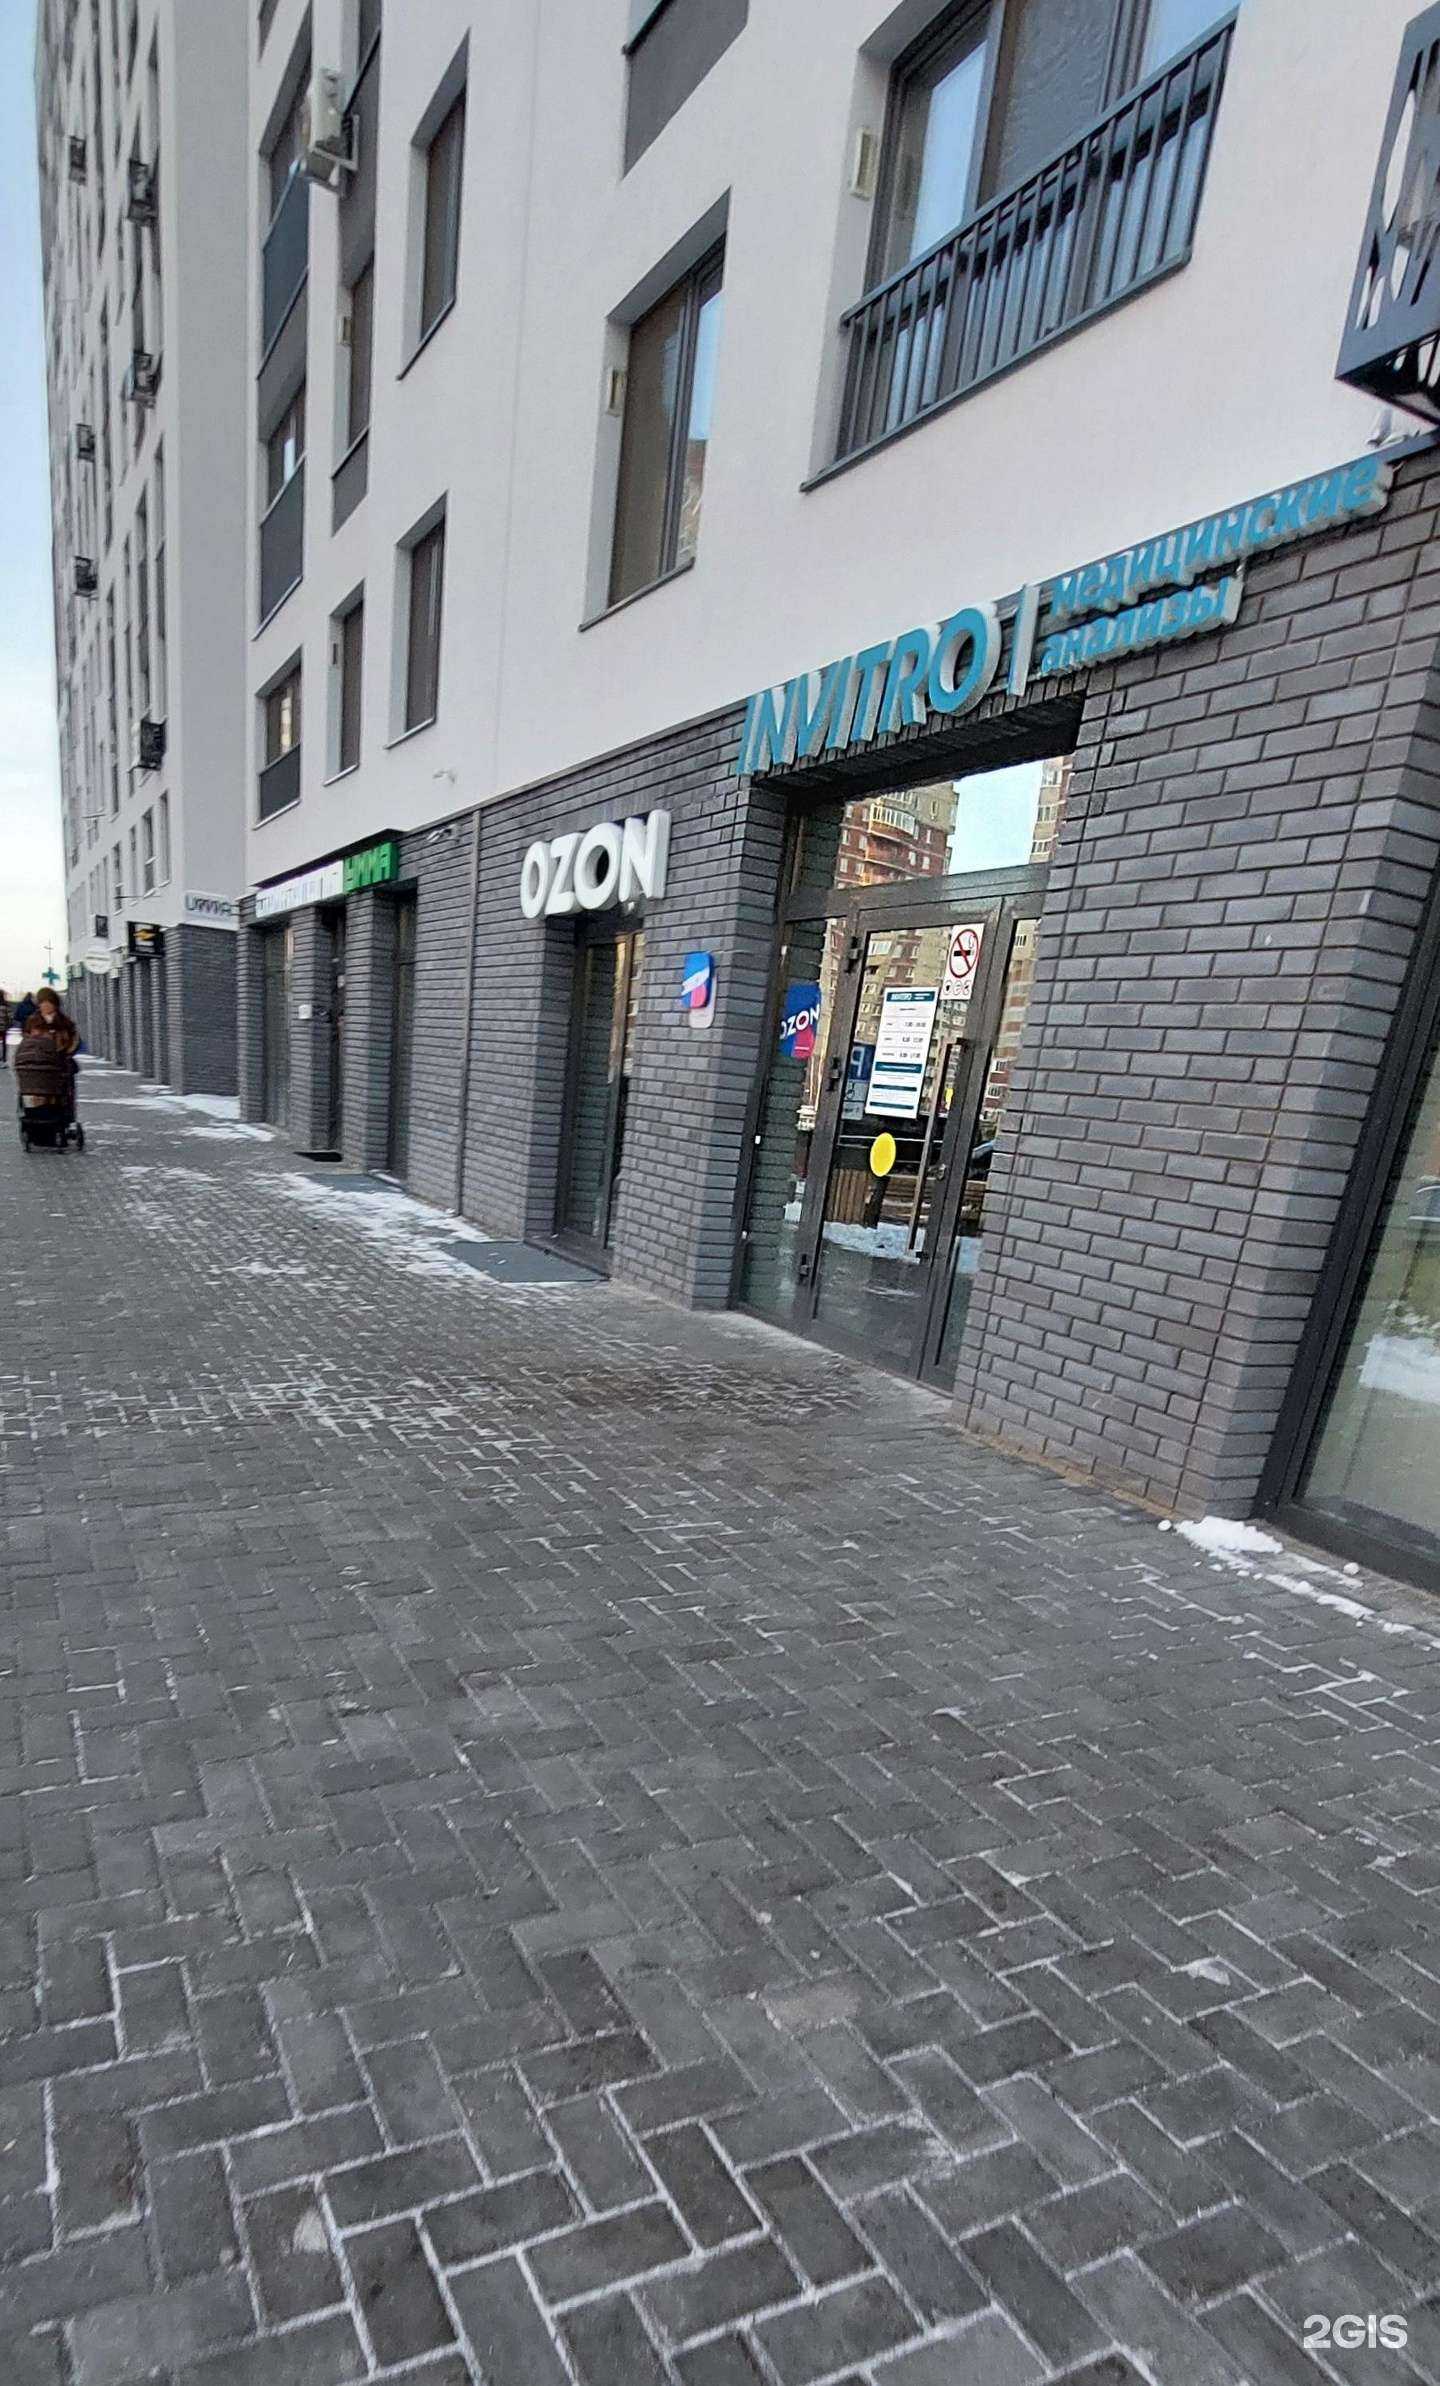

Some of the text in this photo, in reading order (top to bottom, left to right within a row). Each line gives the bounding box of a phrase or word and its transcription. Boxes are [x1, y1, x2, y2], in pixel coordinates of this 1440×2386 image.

[1050, 457, 1392, 618] медицинские
[735, 601, 1000, 776] INVITRO
[1041, 570, 1244, 677] анализы
[520, 809, 671, 918] OZON
